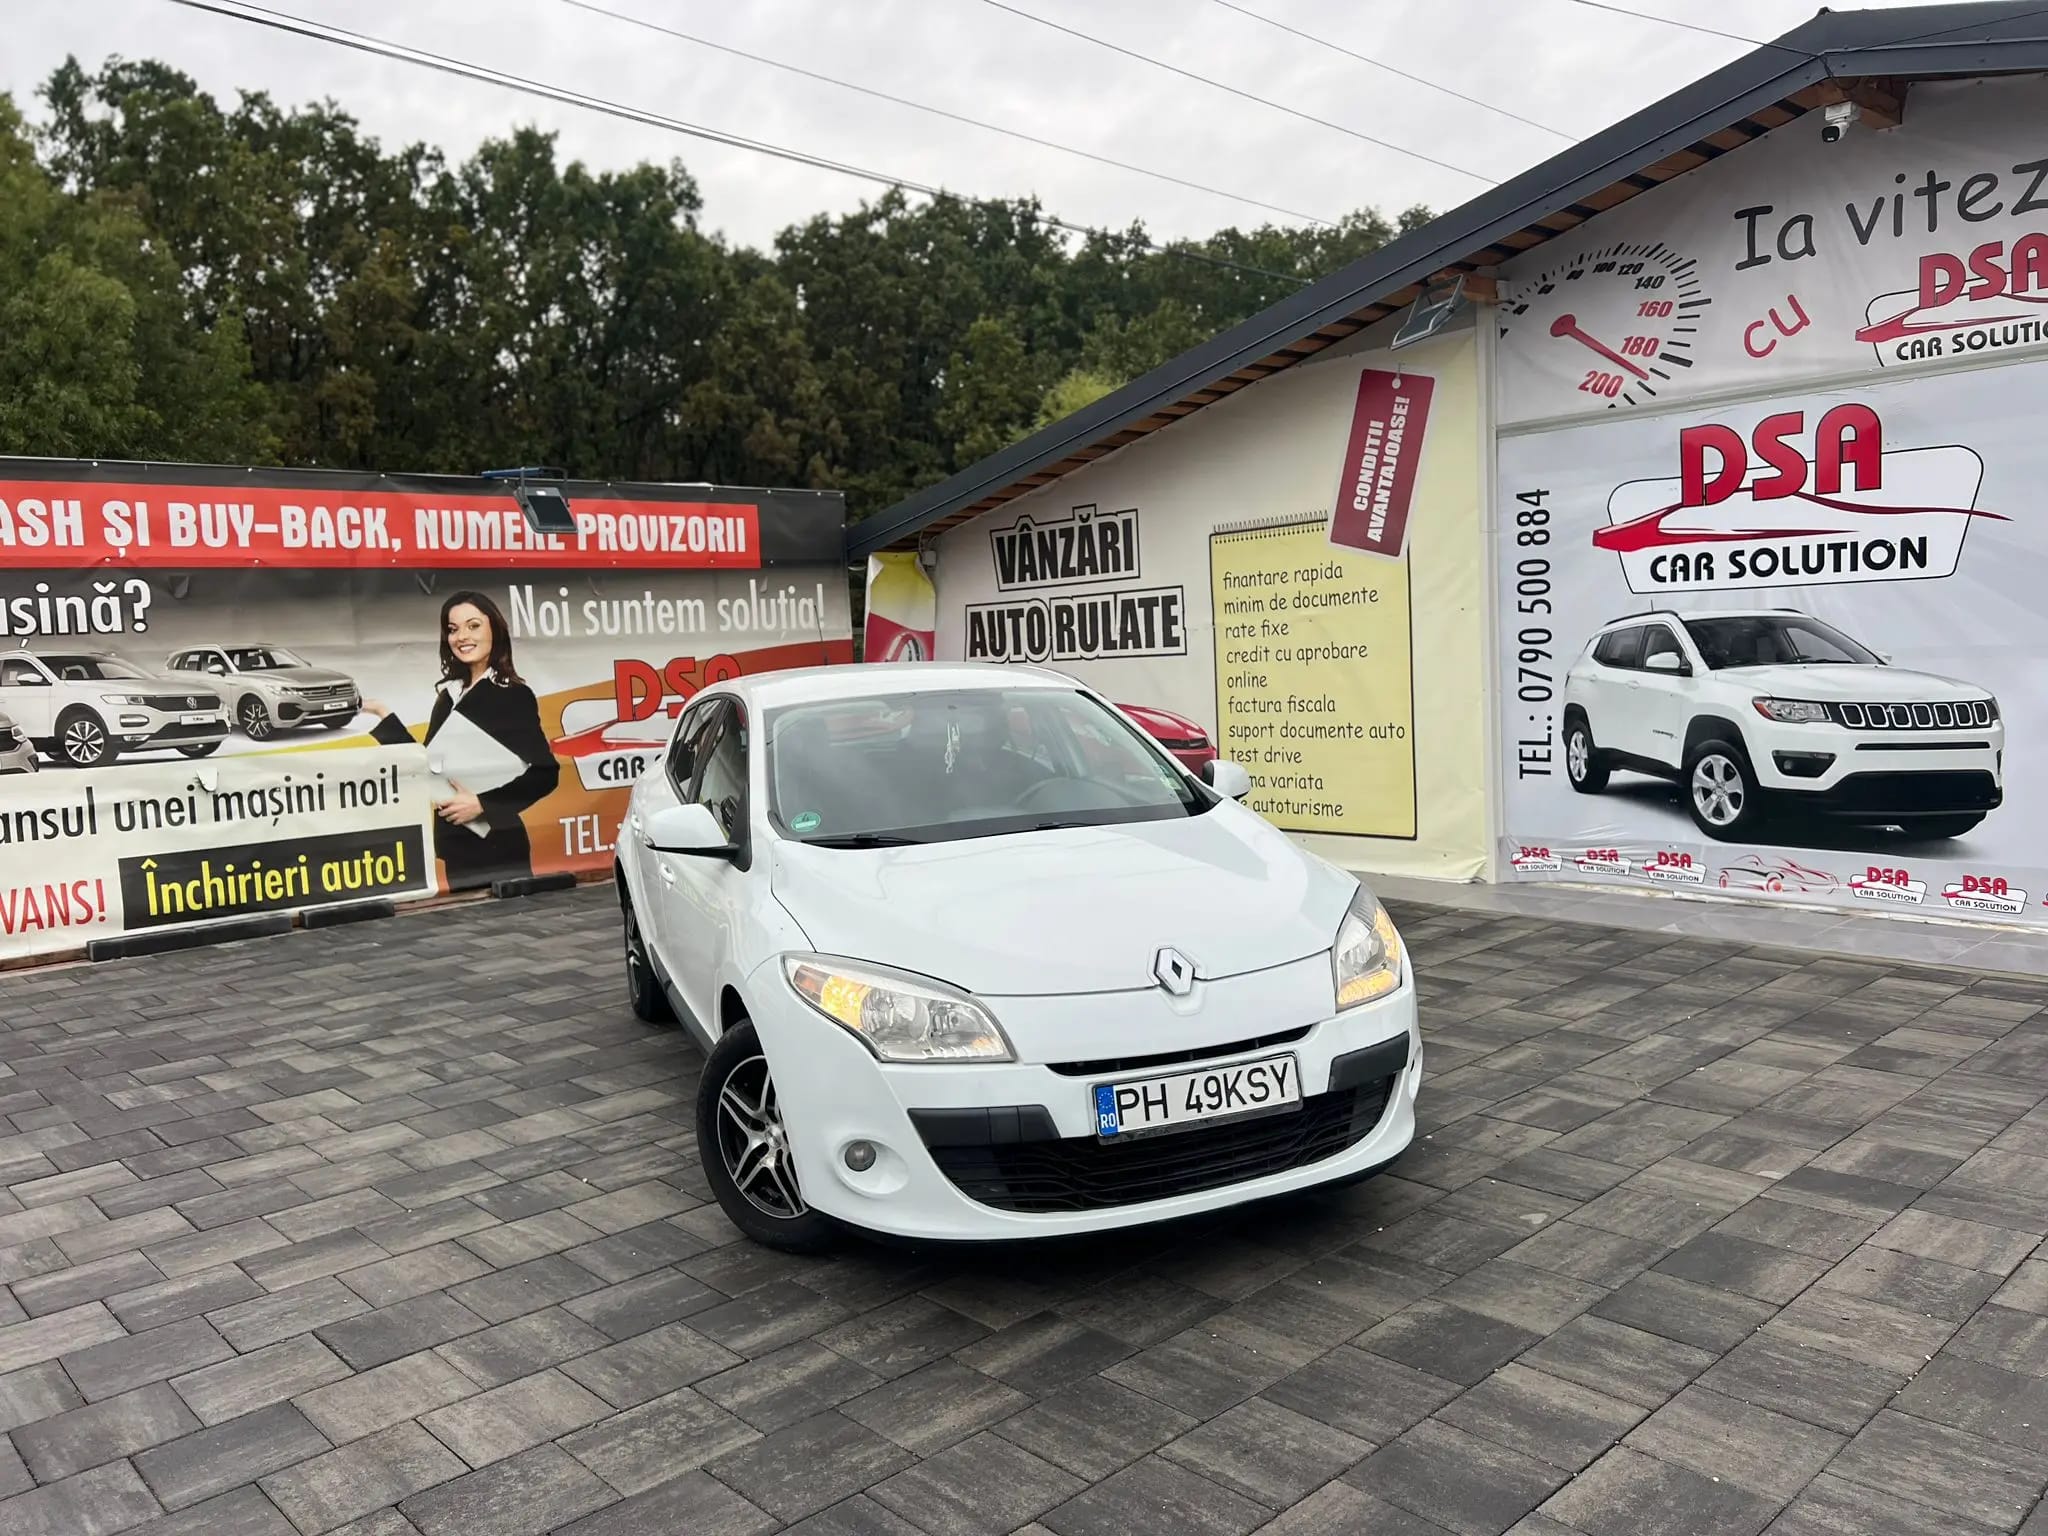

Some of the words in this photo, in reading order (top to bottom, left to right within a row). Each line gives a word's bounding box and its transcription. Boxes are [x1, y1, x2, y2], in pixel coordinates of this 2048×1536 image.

[1734, 205, 1816, 271] Ia
[1592, 261, 1617, 274] 100
[1617, 262, 1645, 276] 120
[1919, 232, 2048, 310] DSA
[1634, 275, 1666, 290] 140
[1637, 301, 1673, 318] 160
[1744, 294, 1812, 358] cu
[1620, 336, 1660, 357] 180
[1896, 339, 1942, 361] CAR
[1578, 370, 1624, 398] 200
[1353, 420, 1384, 511] CONDITII
[1680, 403, 1882, 506] DSA
[1367, 396, 1410, 543] AVANTAJOASE!
[102, 500, 151, 558] ȘI
[169, 501, 402, 552] BUY-BACK,
[576, 513, 746, 552] PROVIZORII
[1516, 489, 1550, 546] 884
[996, 513, 1134, 584] VÂNZĂRI
[1650, 552, 1714, 583] CAR
[1728, 536, 1927, 579] SOLUTION
[1223, 570, 1289, 590] finantare
[1294, 561, 1343, 586] rapida
[1516, 559, 1551, 614] 500
[509, 585, 572, 637] Noi
[582, 591, 706, 636] suntem
[717, 579, 825, 640] soluția!
[1224, 597, 1264, 614] minim
[1269, 593, 1288, 610] de
[1293, 587, 1379, 609] documente
[0, 579, 151, 648] șină?
[970, 606, 1048, 657] AUTO
[1055, 595, 1180, 653] RULATE
[1225, 622, 1256, 639] rate
[1261, 619, 1289, 637] fixe
[1227, 645, 1270, 664] credit
[1276, 649, 1292, 661] cu
[1296, 641, 1368, 665] aprobare
[1516, 628, 1551, 702] 0790
[1227, 671, 1268, 688] online
[1228, 696, 1282, 714] factura
[1287, 694, 1336, 714] fiscala
[1228, 721, 1275, 742] suport
[1280, 720, 1364, 739] documente
[1369, 722, 1405, 739] auto
[1230, 747, 1259, 762] test
[1264, 746, 1302, 764] drive
[1516, 716, 1551, 779] TEL.:
[599, 756, 645, 781] CAR
[1270, 772, 1324, 790] variata
[113, 784, 197, 832] unei
[213, 773, 325, 827] mașini
[339, 764, 401, 809] noi!
[1252, 798, 1344, 816] autoturisme
[1587, 849, 1619, 862] DSA
[1658, 852, 1691, 868] DSA
[141, 857, 310, 916] Închirieri
[321, 840, 406, 892] auto!
[1667, 873, 1699, 882] SOLUTION
[1867, 866, 1909, 887] DSA
[1963, 875, 2007, 896] DSA
[1876, 891, 1917, 902] SOLUTION
[1955, 899, 1971, 907] CAR
[1973, 901, 2017, 912] SOLUTION
[1116, 1083, 1169, 1126] PH
[1185, 1063, 1289, 1113] 49KSY
[1100, 1113, 1116, 1128] RO
